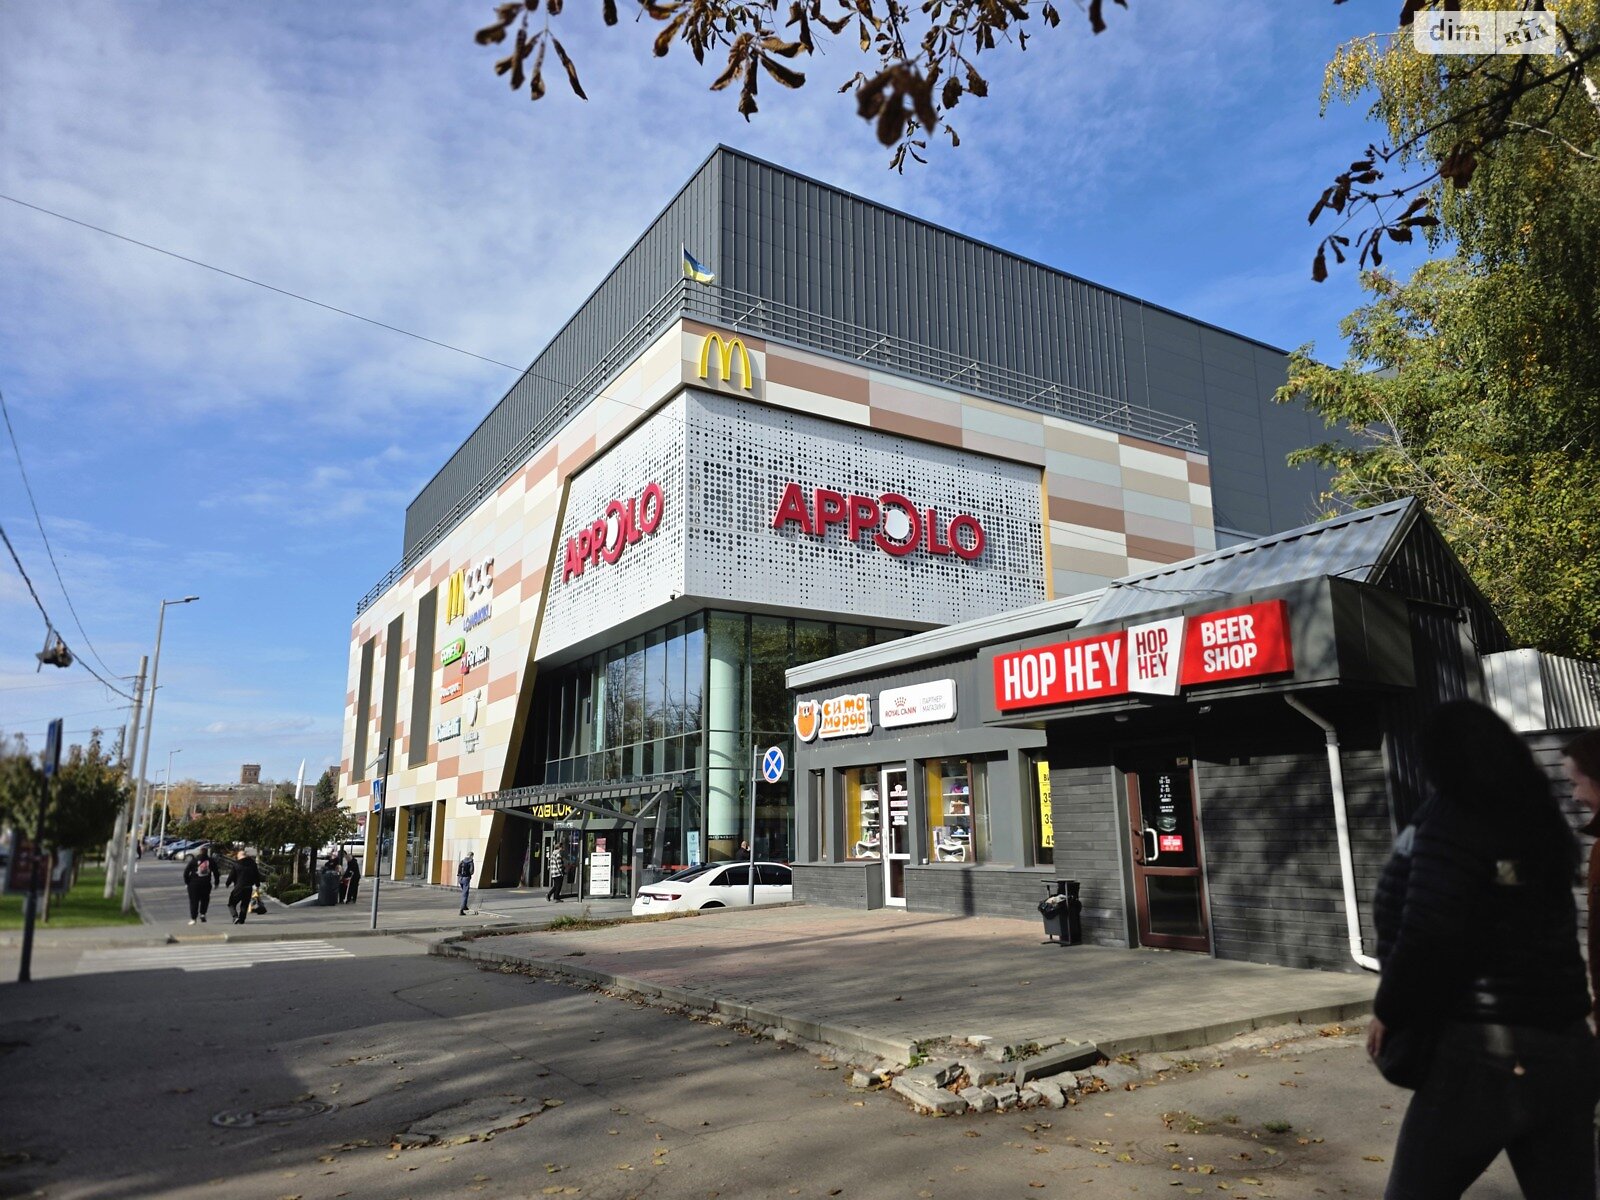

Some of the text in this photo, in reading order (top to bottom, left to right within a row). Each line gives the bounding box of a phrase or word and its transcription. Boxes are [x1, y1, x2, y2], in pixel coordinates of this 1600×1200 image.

[562, 482, 664, 583] APPOLO
[772, 481, 986, 560] APPOLO
[464, 556, 494, 601] CCC
[1135, 627, 1168, 656] HOP
[1201, 614, 1255, 647] BEER
[1003, 639, 1121, 701] HOP HEY
[1138, 652, 1168, 680] HEY
[1203, 642, 1257, 673] SHOP
[885, 706, 917, 717] ROYAL CANIN
[532, 803, 581, 818] YABLUK
